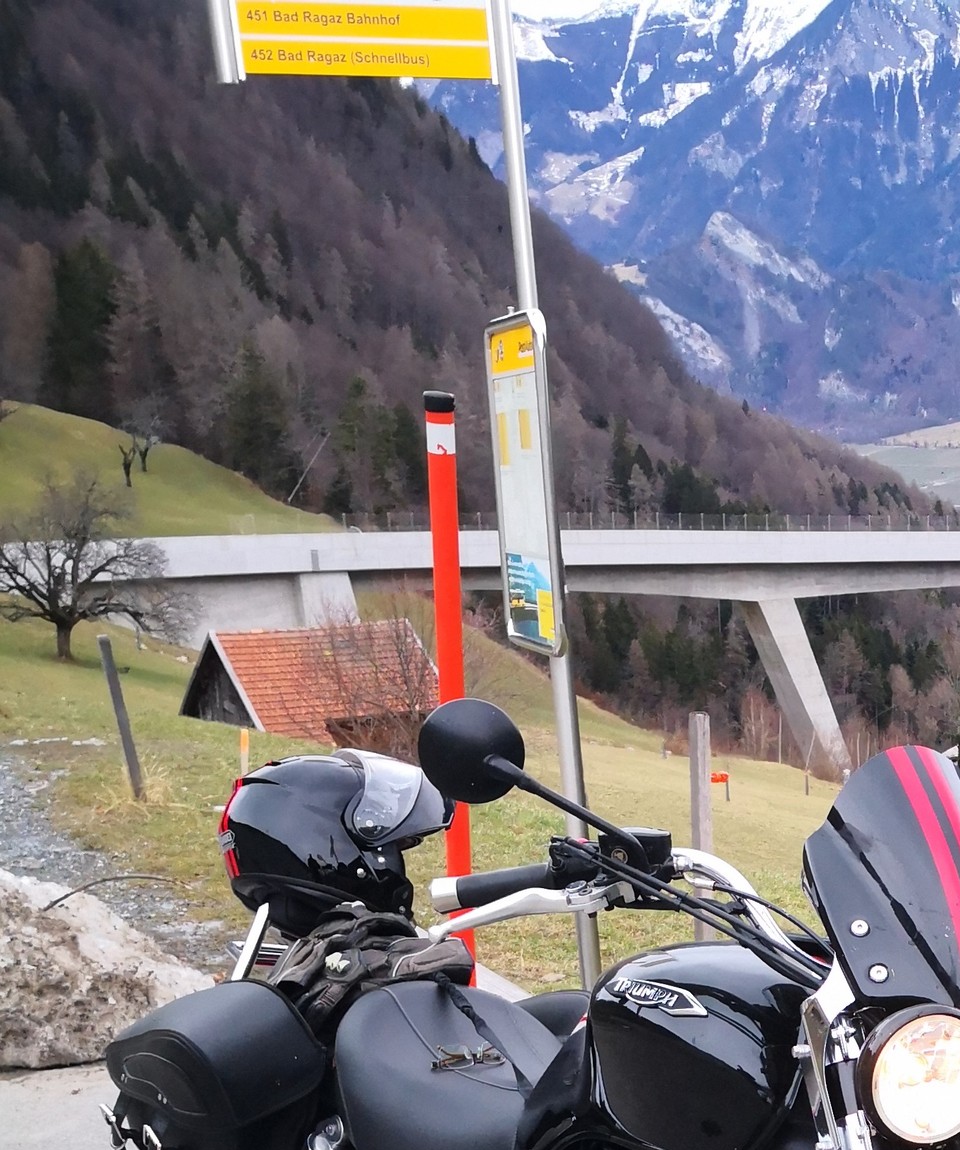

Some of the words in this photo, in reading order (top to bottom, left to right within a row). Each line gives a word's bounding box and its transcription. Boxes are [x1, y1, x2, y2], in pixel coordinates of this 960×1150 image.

[246, 10, 268, 21] 451
[273, 10, 299, 22] Bad
[303, 11, 342, 26] Ragaz
[346, 12, 400, 26] Bahnhof
[250, 49, 273, 61] 452
[277, 49, 303, 61] Bad
[307, 50, 347, 65] Ragaz
[350, 51, 430, 67] (Schnellbus)
[613, 977, 679, 1007] TRIUMPH
